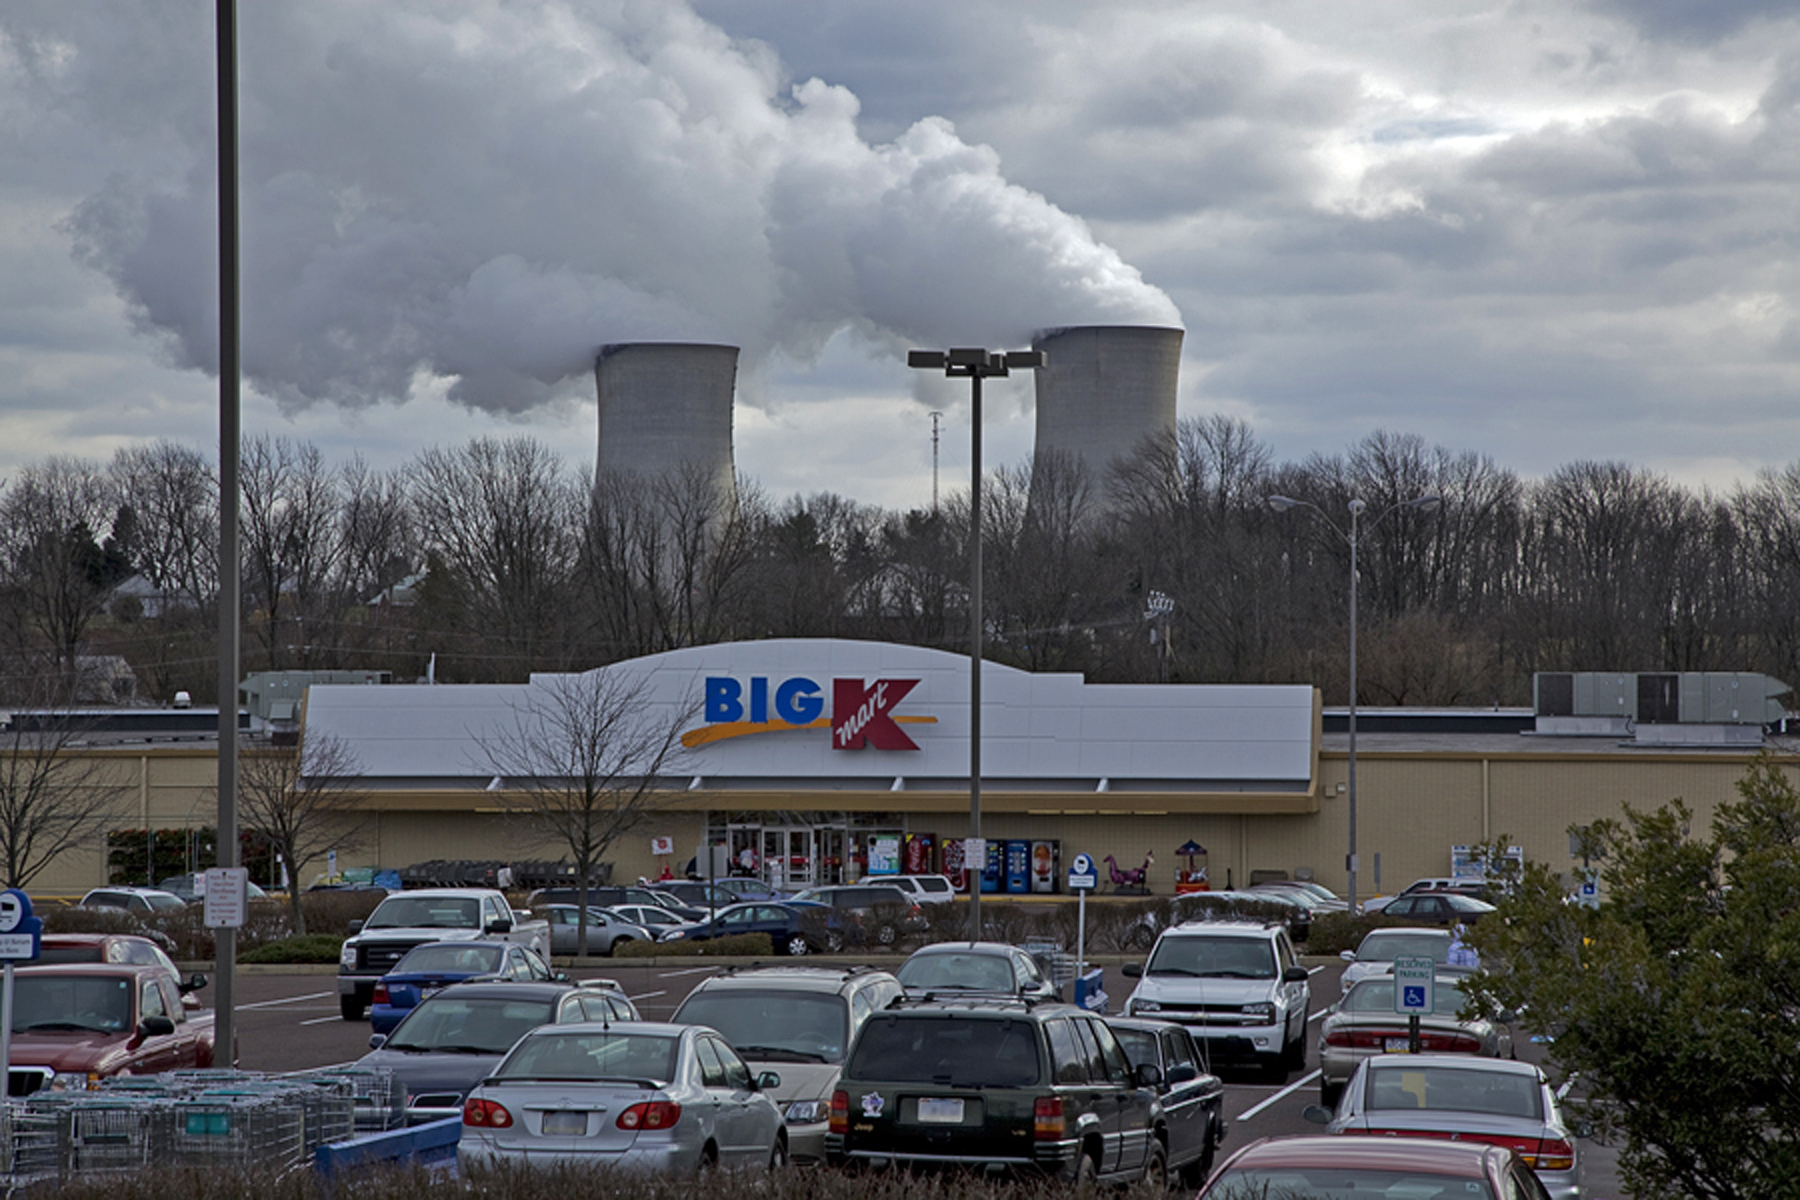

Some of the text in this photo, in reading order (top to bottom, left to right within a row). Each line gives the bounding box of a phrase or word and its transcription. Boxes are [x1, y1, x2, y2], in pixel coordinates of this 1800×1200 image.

[704, 676, 825, 726] BIG
[835, 682, 889, 746] mart
[1396, 960, 1432, 969] RESERVED
[1399, 970, 1430, 979] PARKING
